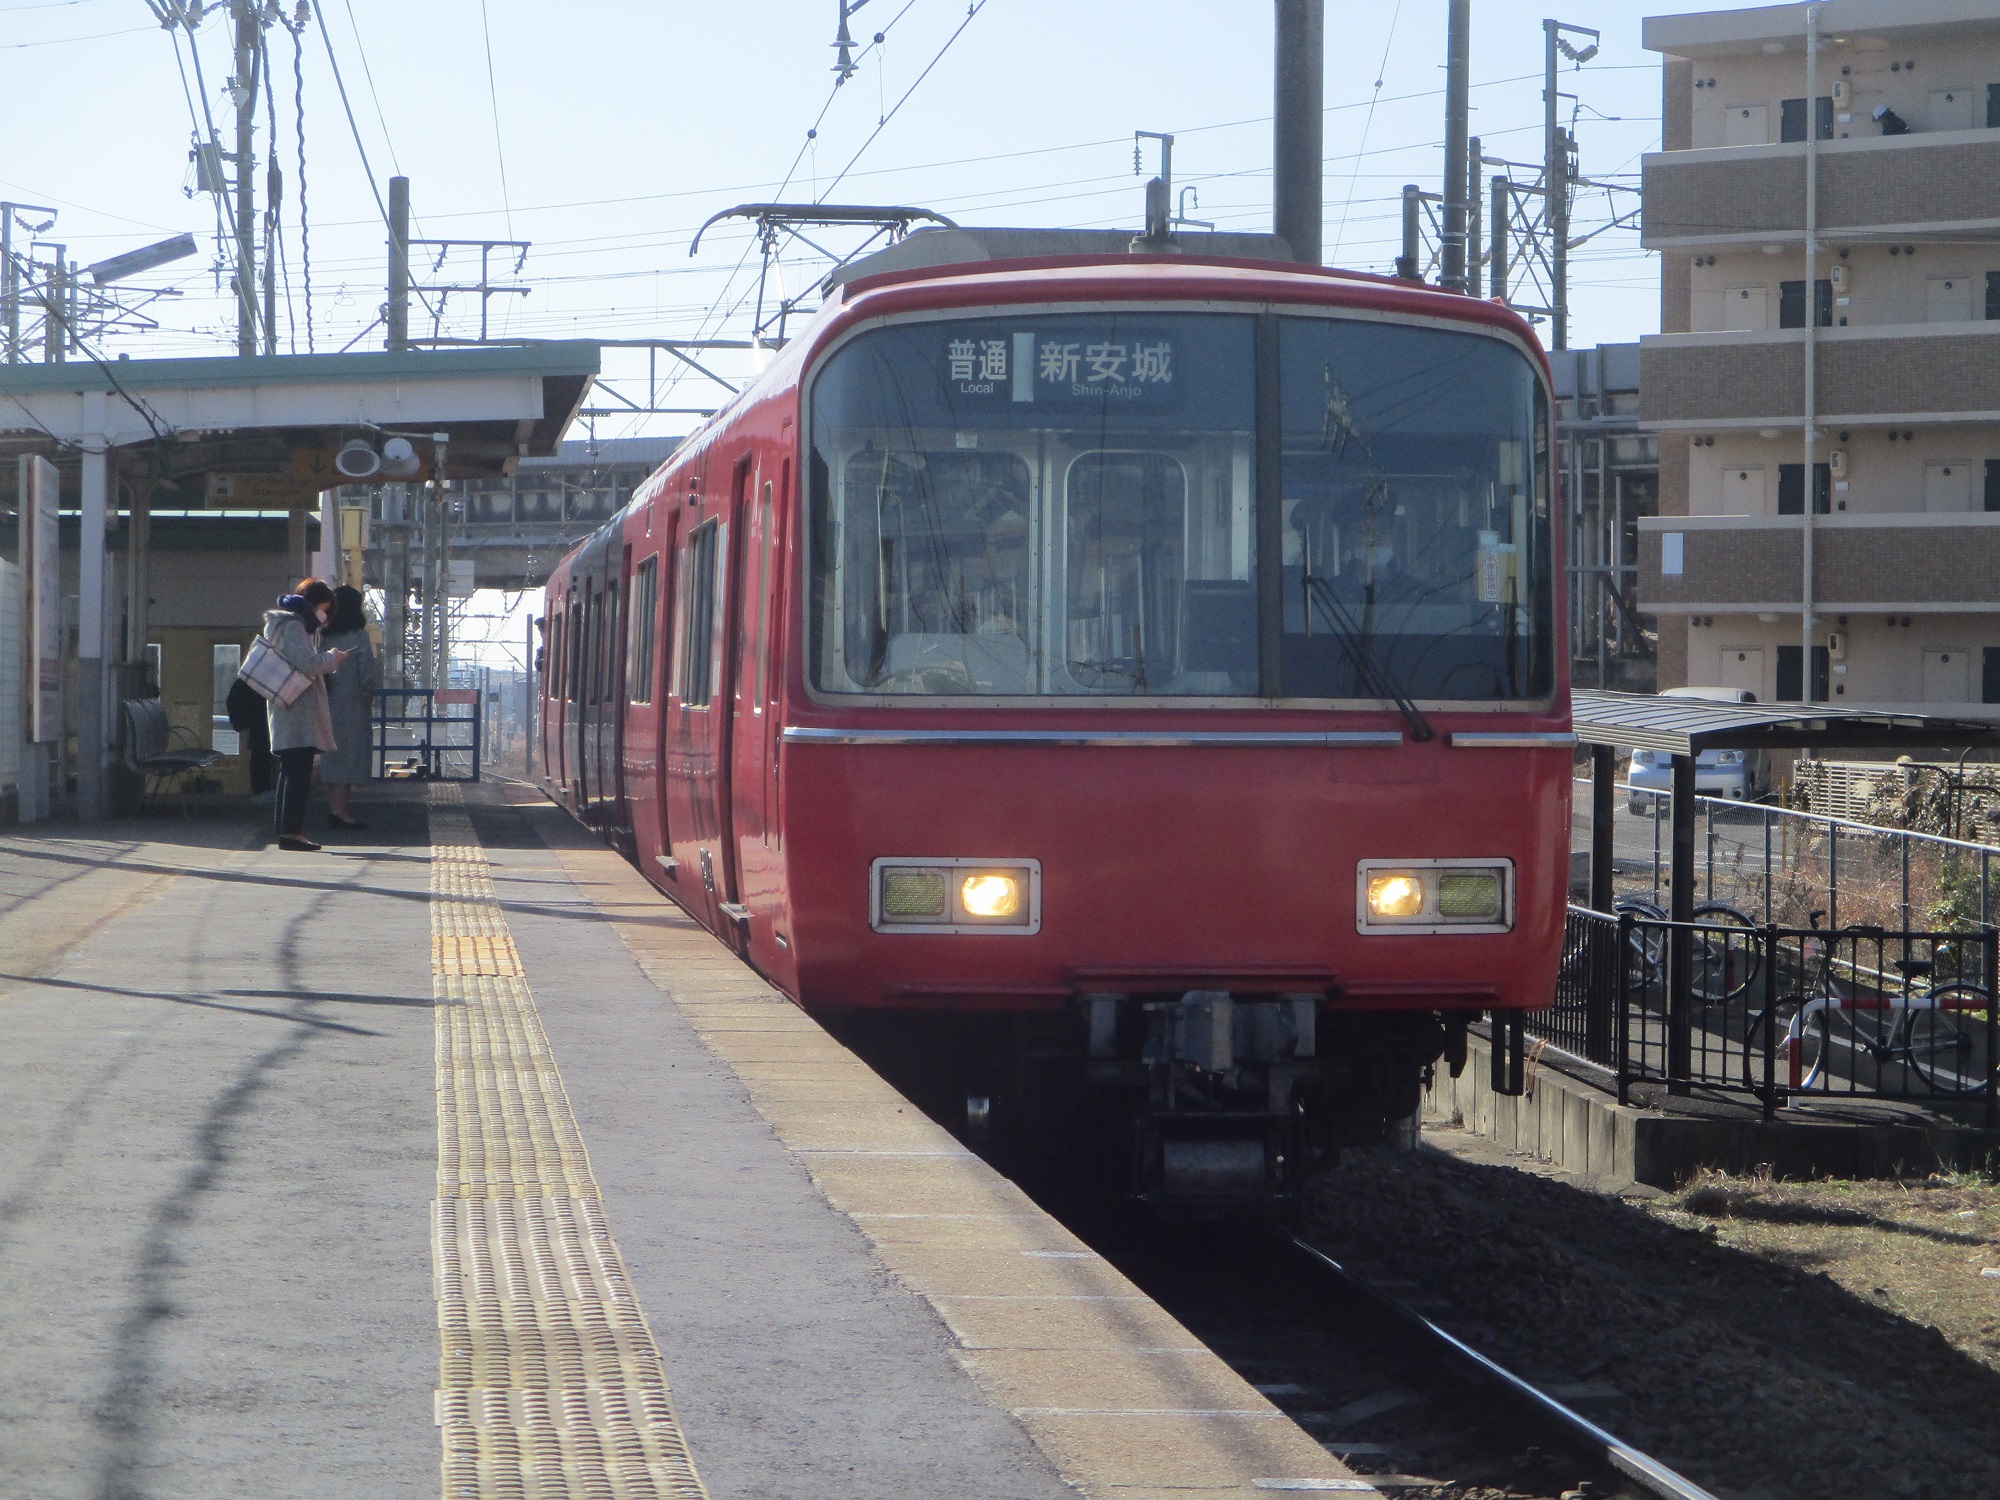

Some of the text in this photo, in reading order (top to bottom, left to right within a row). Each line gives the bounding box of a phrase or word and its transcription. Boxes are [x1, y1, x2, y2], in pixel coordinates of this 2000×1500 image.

[948, 338, 1007, 381] 普通
[1040, 340, 1173, 383] 新安城
[960, 381, 994, 393] Local
[1071, 383, 1142, 398] Shin-Anjo
